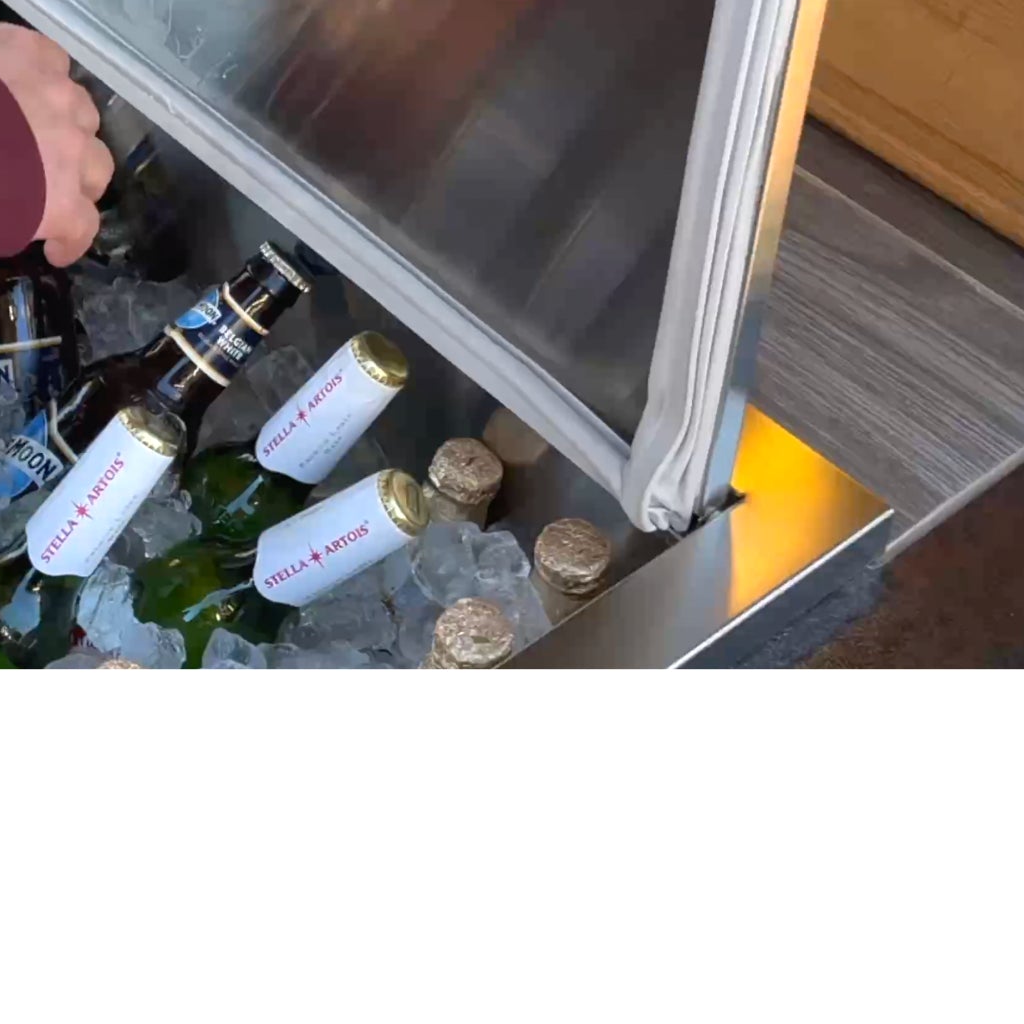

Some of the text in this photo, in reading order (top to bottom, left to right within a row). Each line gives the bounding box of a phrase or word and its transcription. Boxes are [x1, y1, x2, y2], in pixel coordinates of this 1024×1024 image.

[262, 420, 298, 457] STELLA
[307, 373, 343, 412] ARTOIS
[40, 519, 79, 564] STELLA
[87, 456, 125, 506] ARTOIS
[264, 524, 369, 589] STELLA ARTOIS
